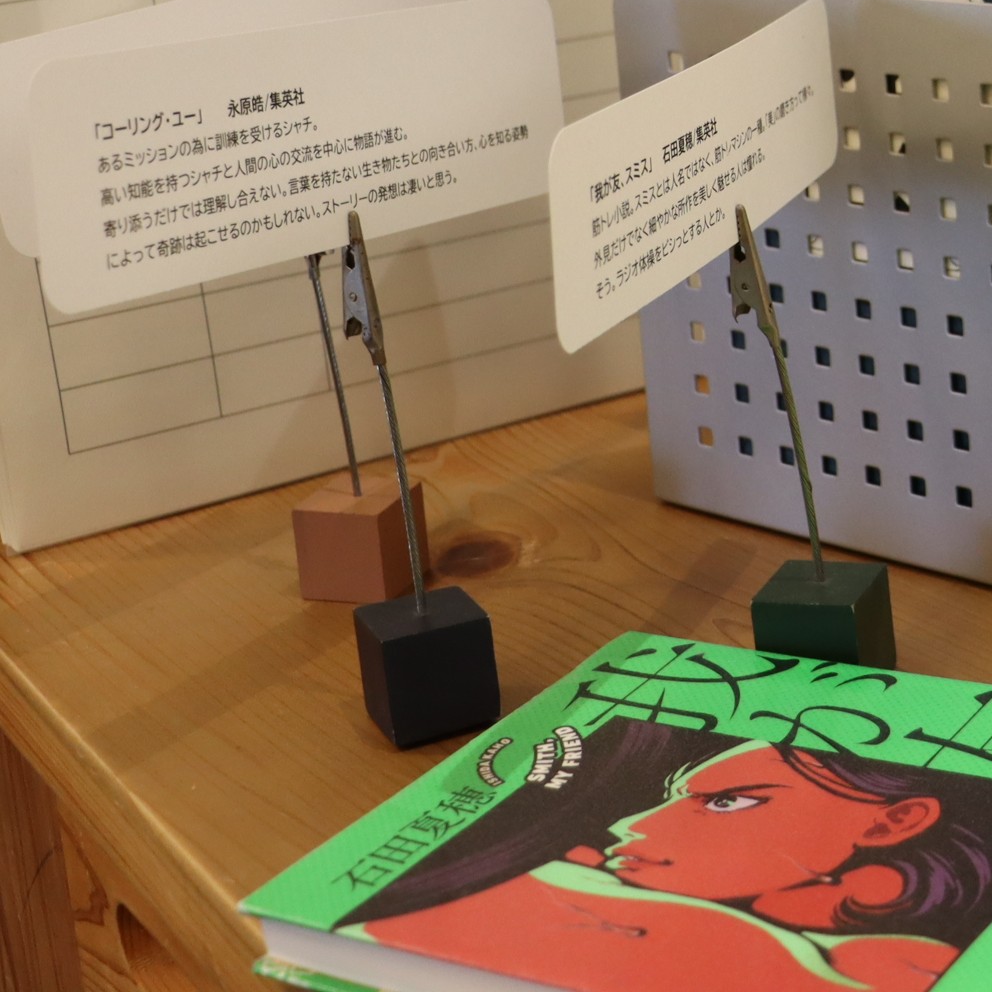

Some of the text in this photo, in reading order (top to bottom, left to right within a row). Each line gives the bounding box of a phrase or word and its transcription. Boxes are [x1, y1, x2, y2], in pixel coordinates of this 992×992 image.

[97, 116, 319, 174] あるミッションの為に訓練を受けるシャチ。
[100, 127, 408, 208] 高い知能を持つシャチと人間の心の交流を中心に物語が進む。
[662, 117, 718, 164] 石田夏穂/集英社
[106, 172, 459, 270] によって奇跡は起こせるのかもしれない。ストーリーの発想は凄いと思う。
[526, 738, 556, 783] SMITH,
[544, 725, 583, 790] MY FRIEND
[331, 785, 498, 892] 石田夏穂
